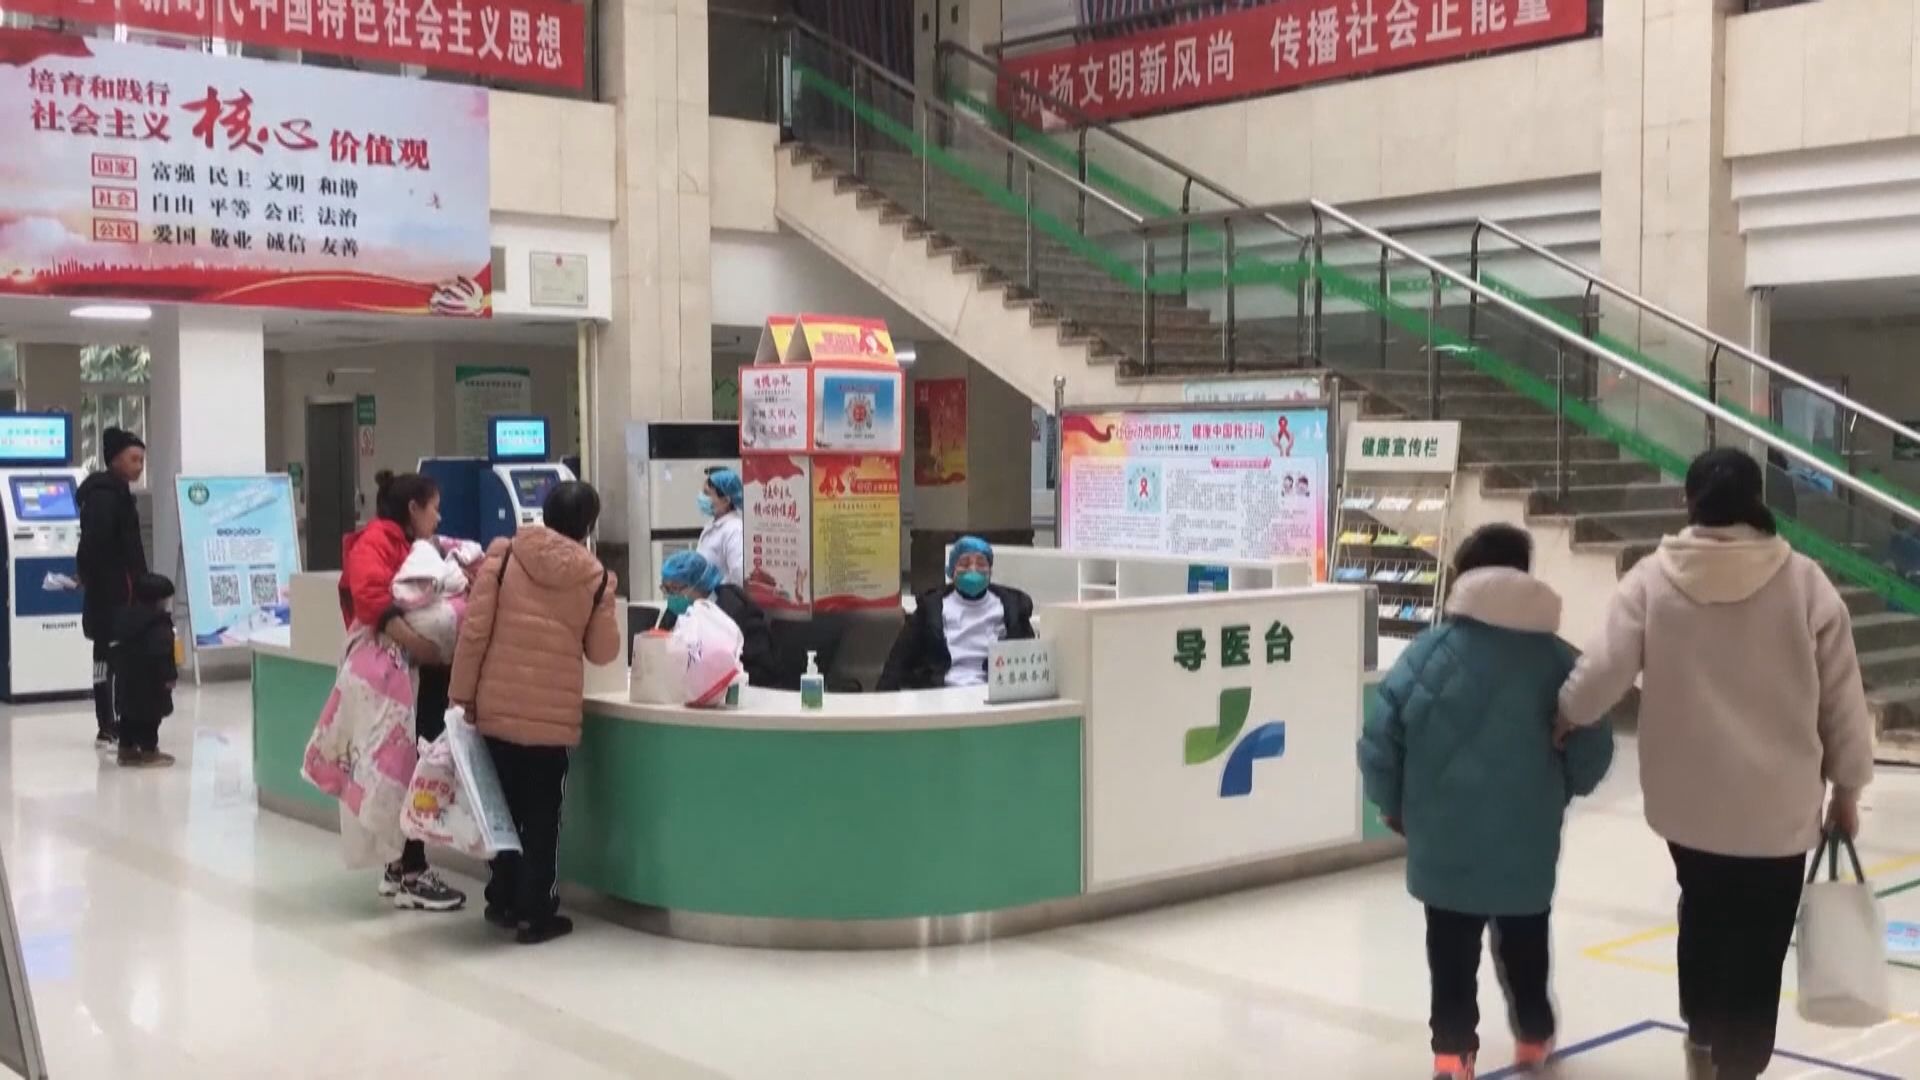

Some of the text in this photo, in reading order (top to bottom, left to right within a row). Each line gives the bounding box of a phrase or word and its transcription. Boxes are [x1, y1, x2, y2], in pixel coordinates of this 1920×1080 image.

[29, 67, 169, 106] 培育和践行
[31, 85, 430, 170] 社会主义 核心 价值观
[152, 160, 195, 183] 富强
[209, 165, 252, 188] 民主
[266, 171, 304, 193] 文明
[319, 176, 358, 198] 和谐
[99, 191, 358, 228] 社会 自由 平等 公正 法治
[100, 223, 358, 258] 公民 爱国 敬业 诚信 友善
[1362, 436, 1438, 458] 健康宣传栏
[1173, 619, 1294, 672] 导医台
